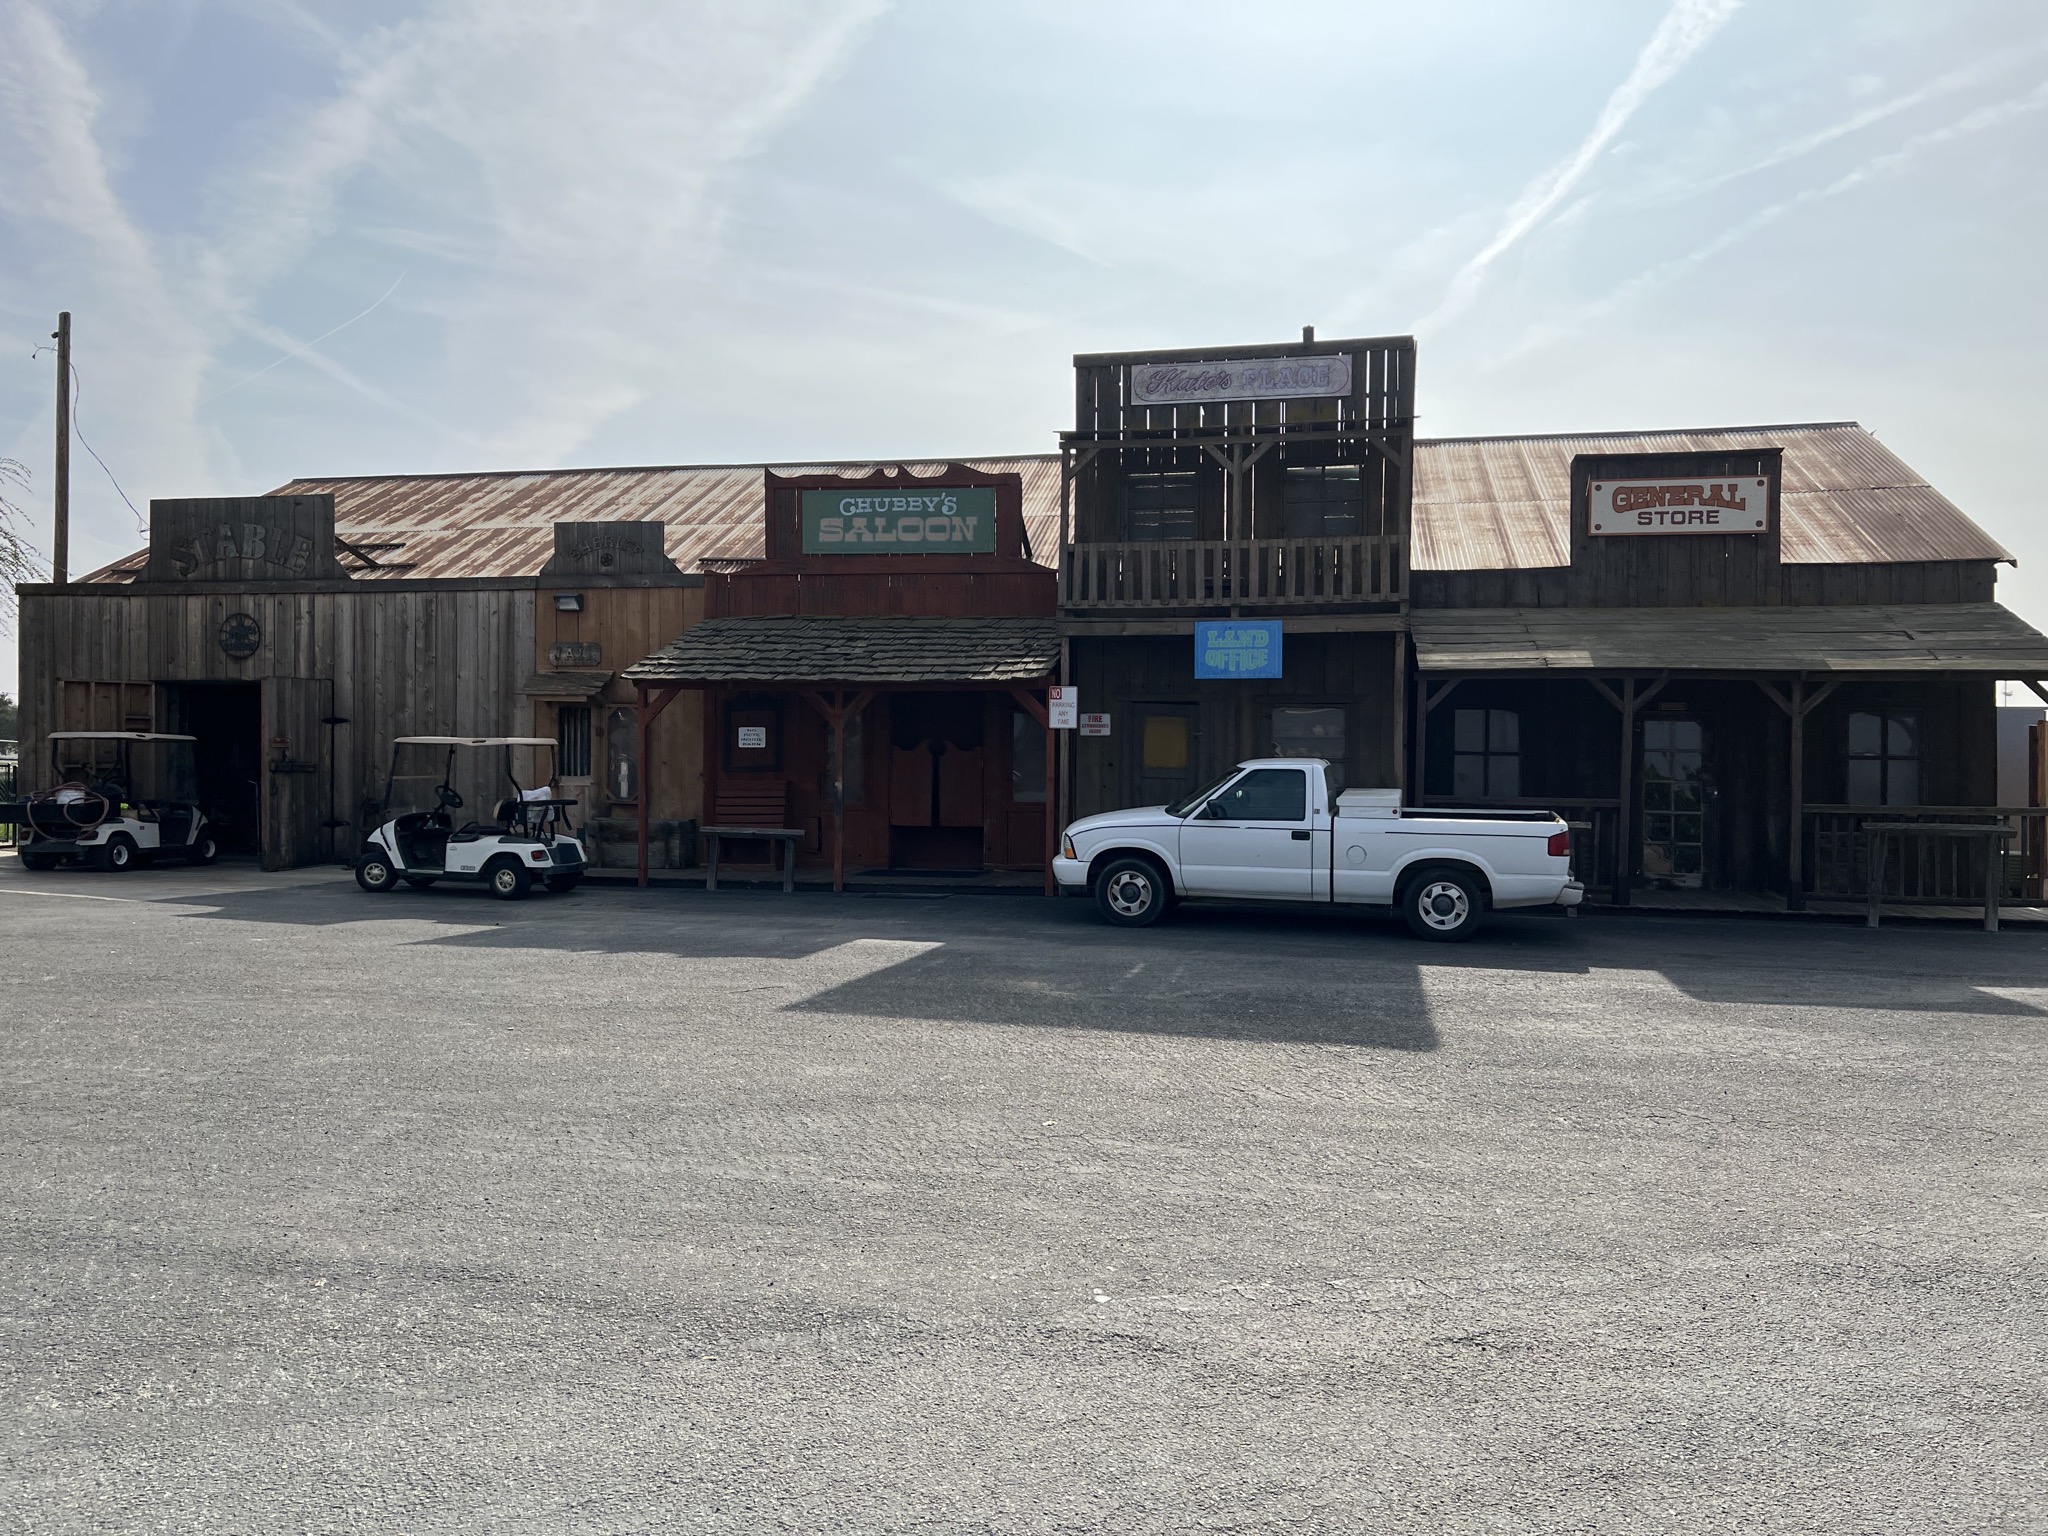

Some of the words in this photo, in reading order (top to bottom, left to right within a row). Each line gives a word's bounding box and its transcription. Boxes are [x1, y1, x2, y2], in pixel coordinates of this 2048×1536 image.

[1146, 367, 1232, 394] Kate's
[1242, 364, 1330, 391] PLACE
[839, 492, 957, 516] CHUBBY'S
[1612, 483, 1746, 513] GENERAL
[819, 516, 978, 542] SALOON
[1637, 510, 1720, 526] STORE
[170, 522, 314, 577] STABLE
[1207, 629, 1269, 648] LAND
[1205, 648, 1269, 672] OFFICE
[1051, 688, 1061, 699] NO
[1051, 701, 1075, 709] PARKING
